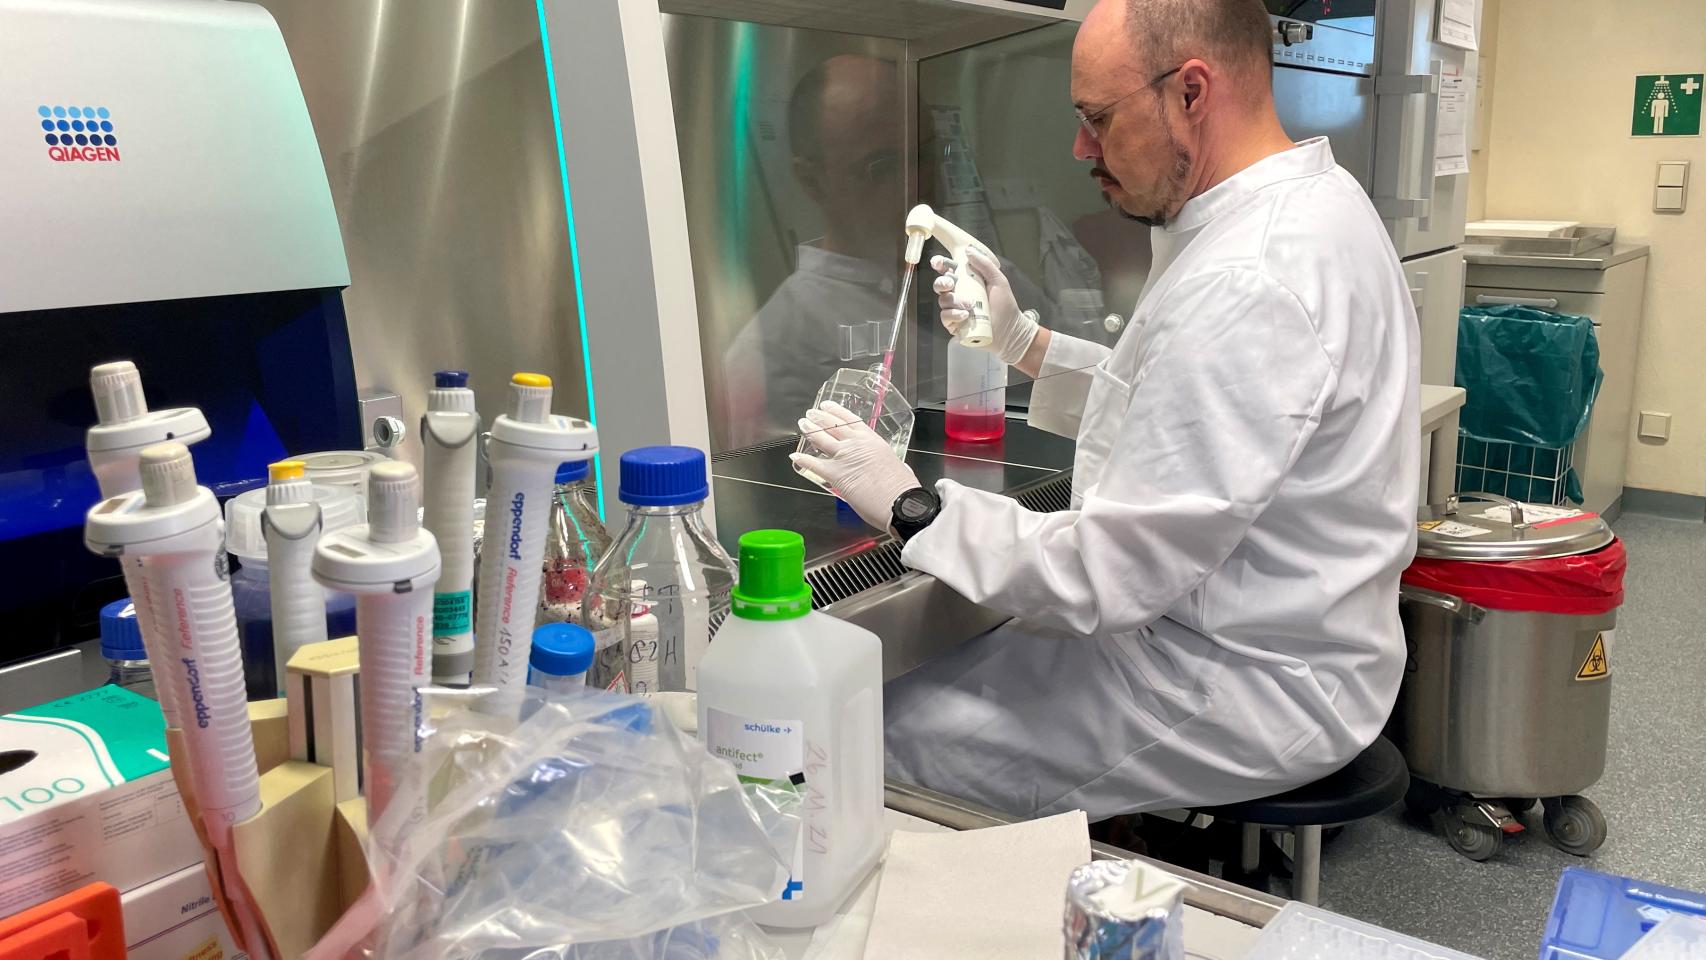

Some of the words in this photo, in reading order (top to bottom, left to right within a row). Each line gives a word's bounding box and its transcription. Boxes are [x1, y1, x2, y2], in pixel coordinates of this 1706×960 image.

[48, 146, 120, 162] QIAGEN
[508, 492, 525, 561] eppendorf
[173, 588, 193, 650] Reference
[501, 566, 518, 624] Reference
[414, 616, 425, 676] Reference
[182, 657, 212, 729] eppendorf
[744, 722, 781, 734] schülke
[0, 777, 85, 812] 100
[180, 896, 211, 915] Nitrile
